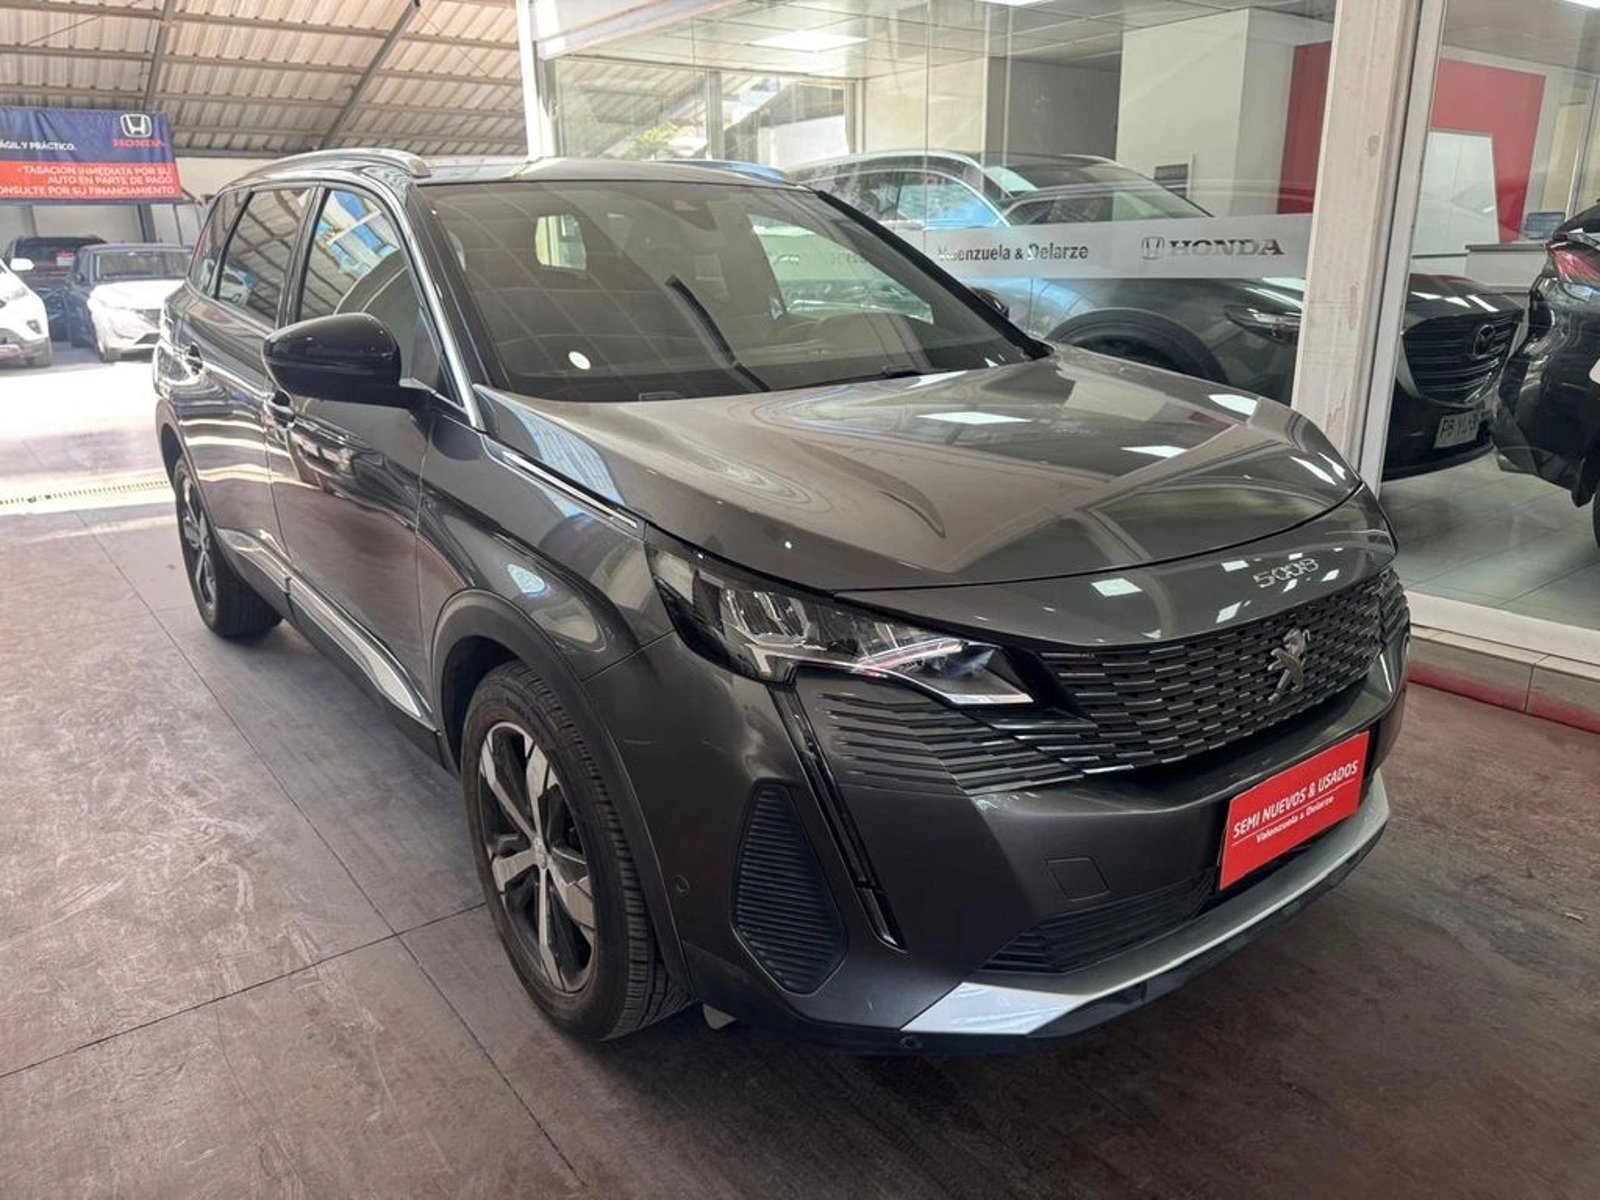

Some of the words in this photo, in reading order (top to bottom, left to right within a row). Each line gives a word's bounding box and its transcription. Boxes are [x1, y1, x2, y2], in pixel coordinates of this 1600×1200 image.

[48, 176, 77, 185] AUTO
[0, 186, 46, 196] ONSULTE
[49, 186, 72, 195] POR
[1015, 248, 1024, 260] &
[1168, 238, 1285, 256] HONDA
[1253, 558, 1319, 588] 5008
[1233, 815, 1261, 839] SEMI
[1262, 788, 1307, 823] NUEVOS
[1308, 783, 1317, 798] &
[1318, 760, 1359, 794] USADOS
